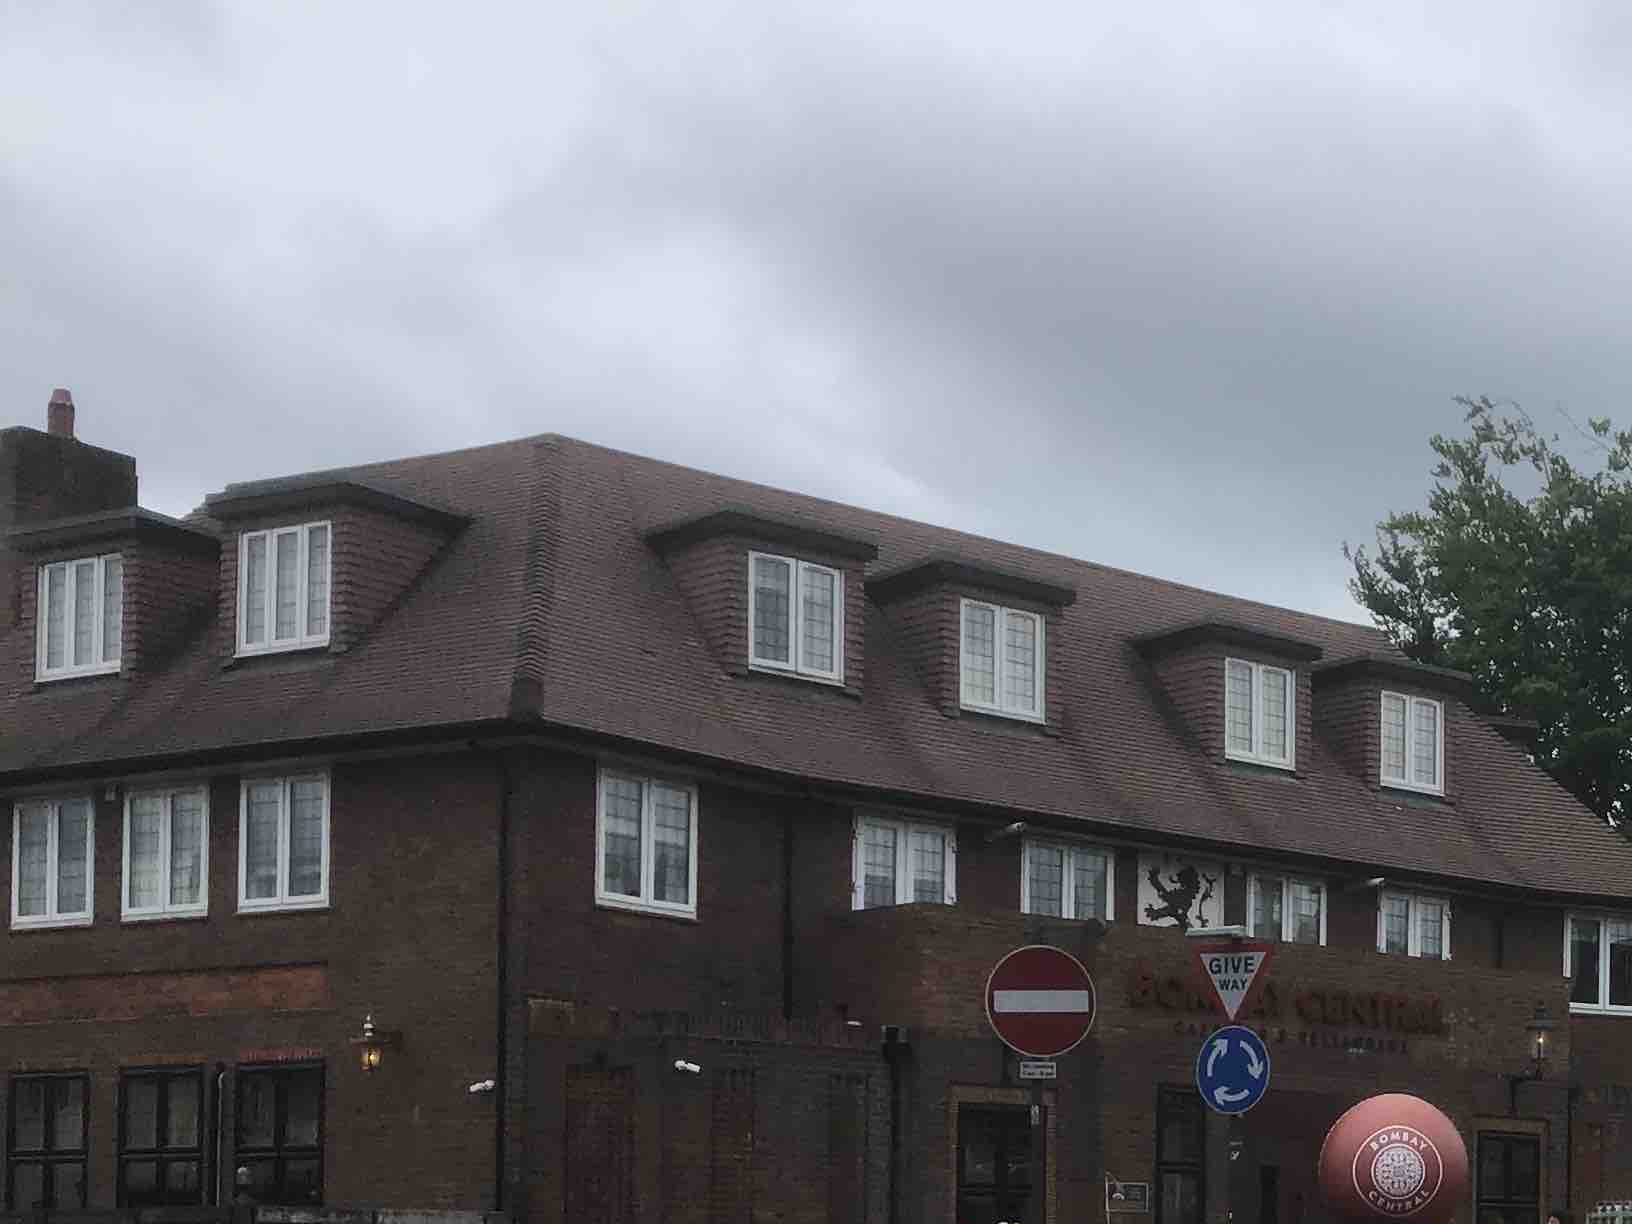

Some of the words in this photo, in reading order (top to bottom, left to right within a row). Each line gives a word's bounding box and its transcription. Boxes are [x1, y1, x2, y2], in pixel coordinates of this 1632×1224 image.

[1209, 956, 1255, 974] GIVE
[1219, 978, 1248, 991] WAY
[1369, 1131, 1428, 1151] BOMBAY
[1369, 1190, 1430, 1211] CENTRAL
